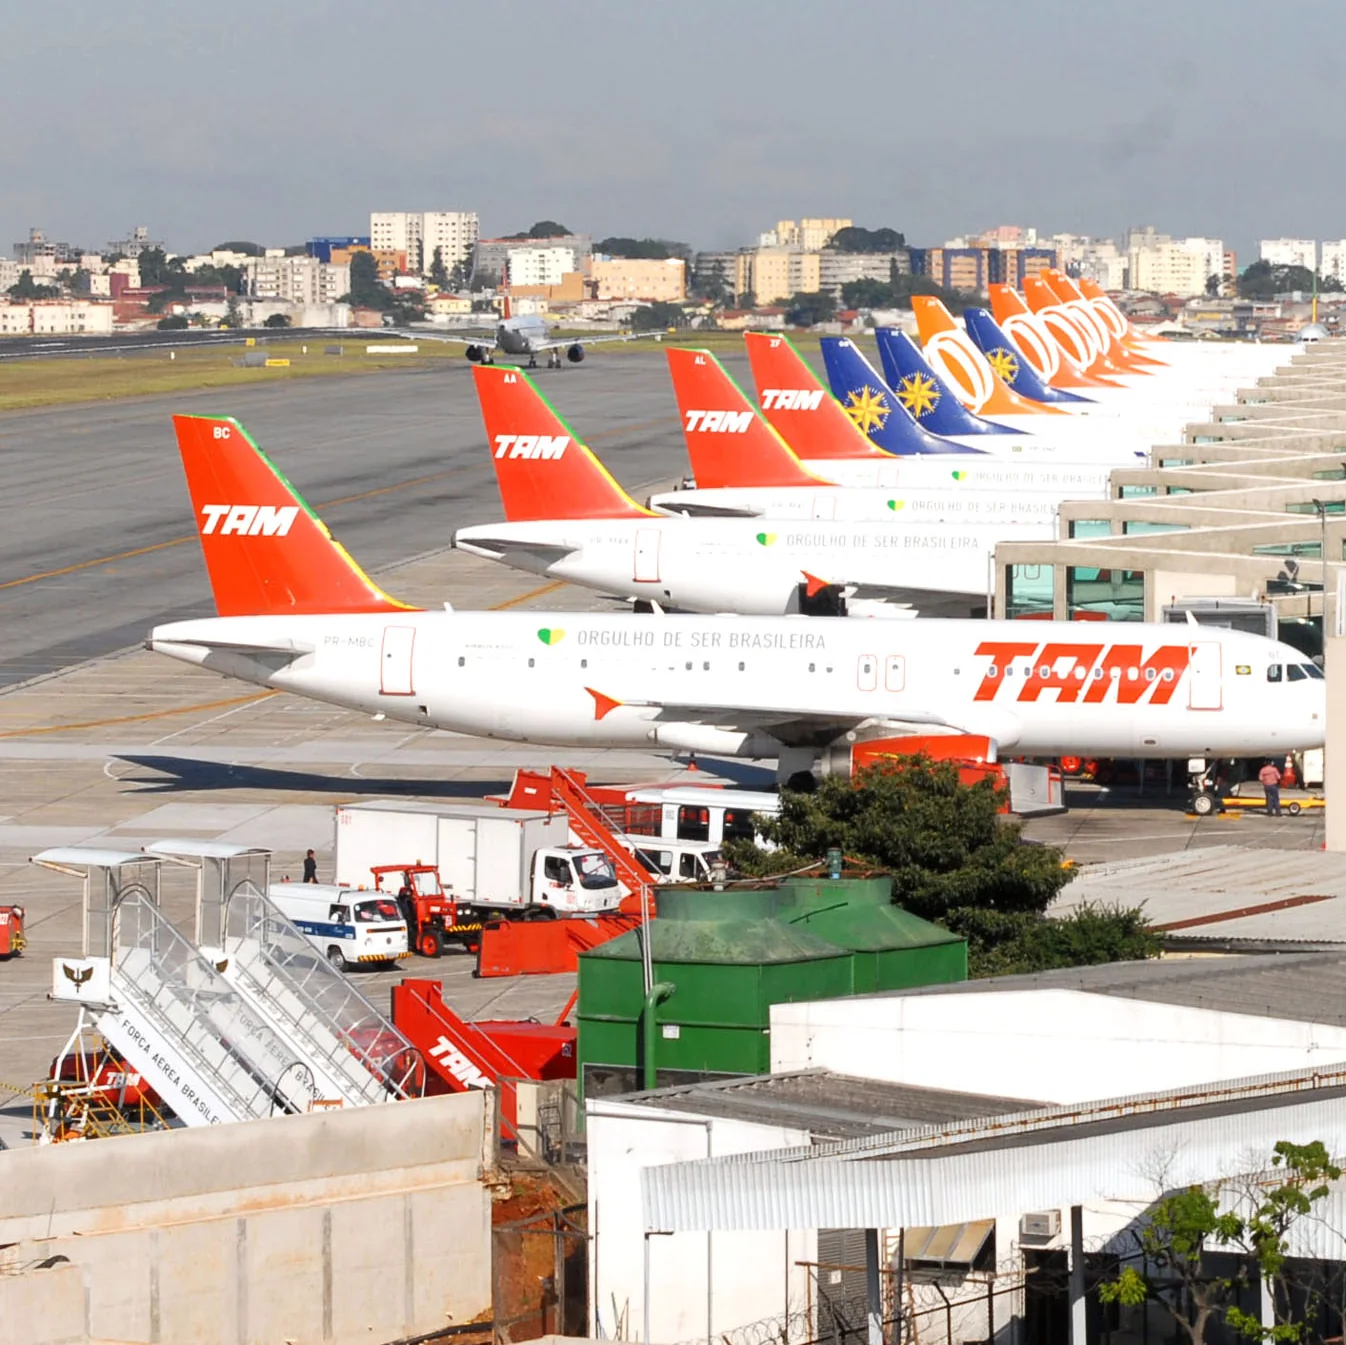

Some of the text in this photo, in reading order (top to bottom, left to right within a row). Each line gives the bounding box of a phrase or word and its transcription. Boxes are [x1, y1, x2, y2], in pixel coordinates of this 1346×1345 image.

[503, 373, 517, 383] AA
[761, 389, 825, 410] TAM
[685, 410, 755, 433] TAM
[213, 426, 231, 439] BC
[494, 434, 571, 460] TAM
[201, 504, 300, 536] TAM
[786, 533, 979, 549] ORGULHO DE SER BRASILEIRA
[323, 635, 376, 648] PR-MBC
[577, 629, 826, 650] ORGULHO DE SER BRASILEIRA
[972, 641, 1199, 705] TAM
[121, 1018, 222, 1125] FORCA AEREA BRASILE
[428, 1035, 496, 1090] TAM
[105, 1071, 141, 1088] TAM
